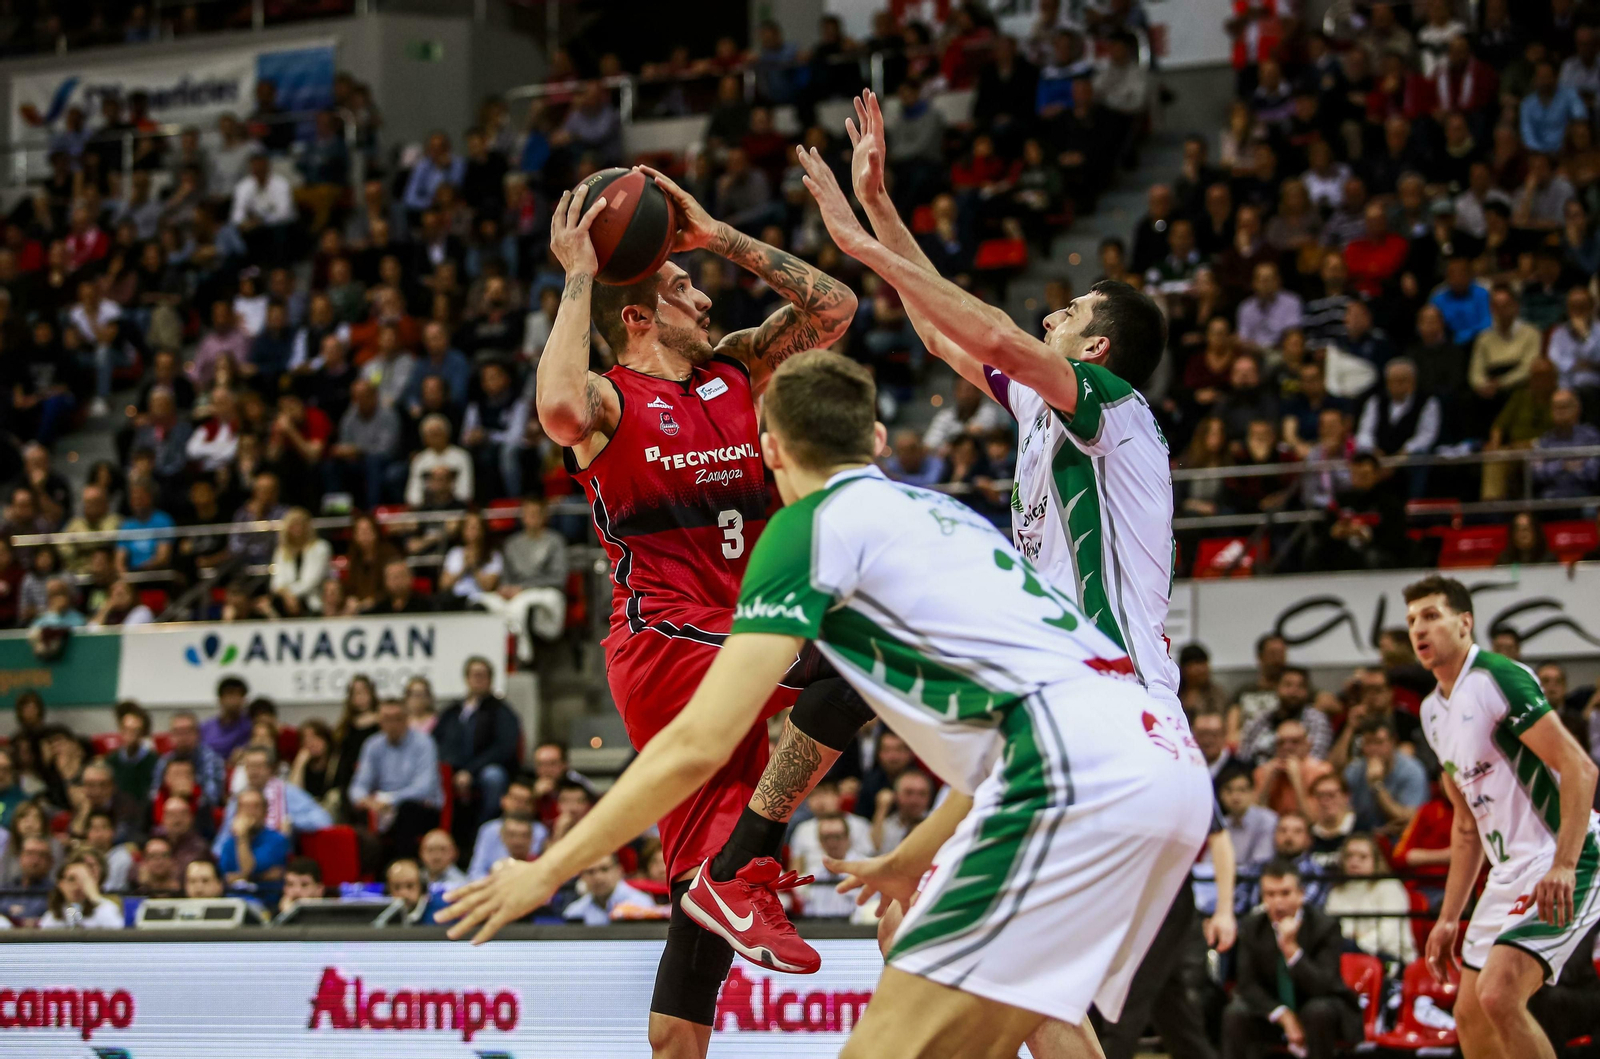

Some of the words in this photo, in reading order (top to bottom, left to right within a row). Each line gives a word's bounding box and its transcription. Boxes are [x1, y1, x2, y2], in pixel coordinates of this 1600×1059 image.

[717, 509, 745, 560] 3
[243, 626, 436, 665] ANAGAN
[292, 666, 434, 695] SEGRO
[1485, 829, 1511, 863] 12
[308, 966, 519, 1042] Alcampo
[713, 966, 873, 1032] Alcam
